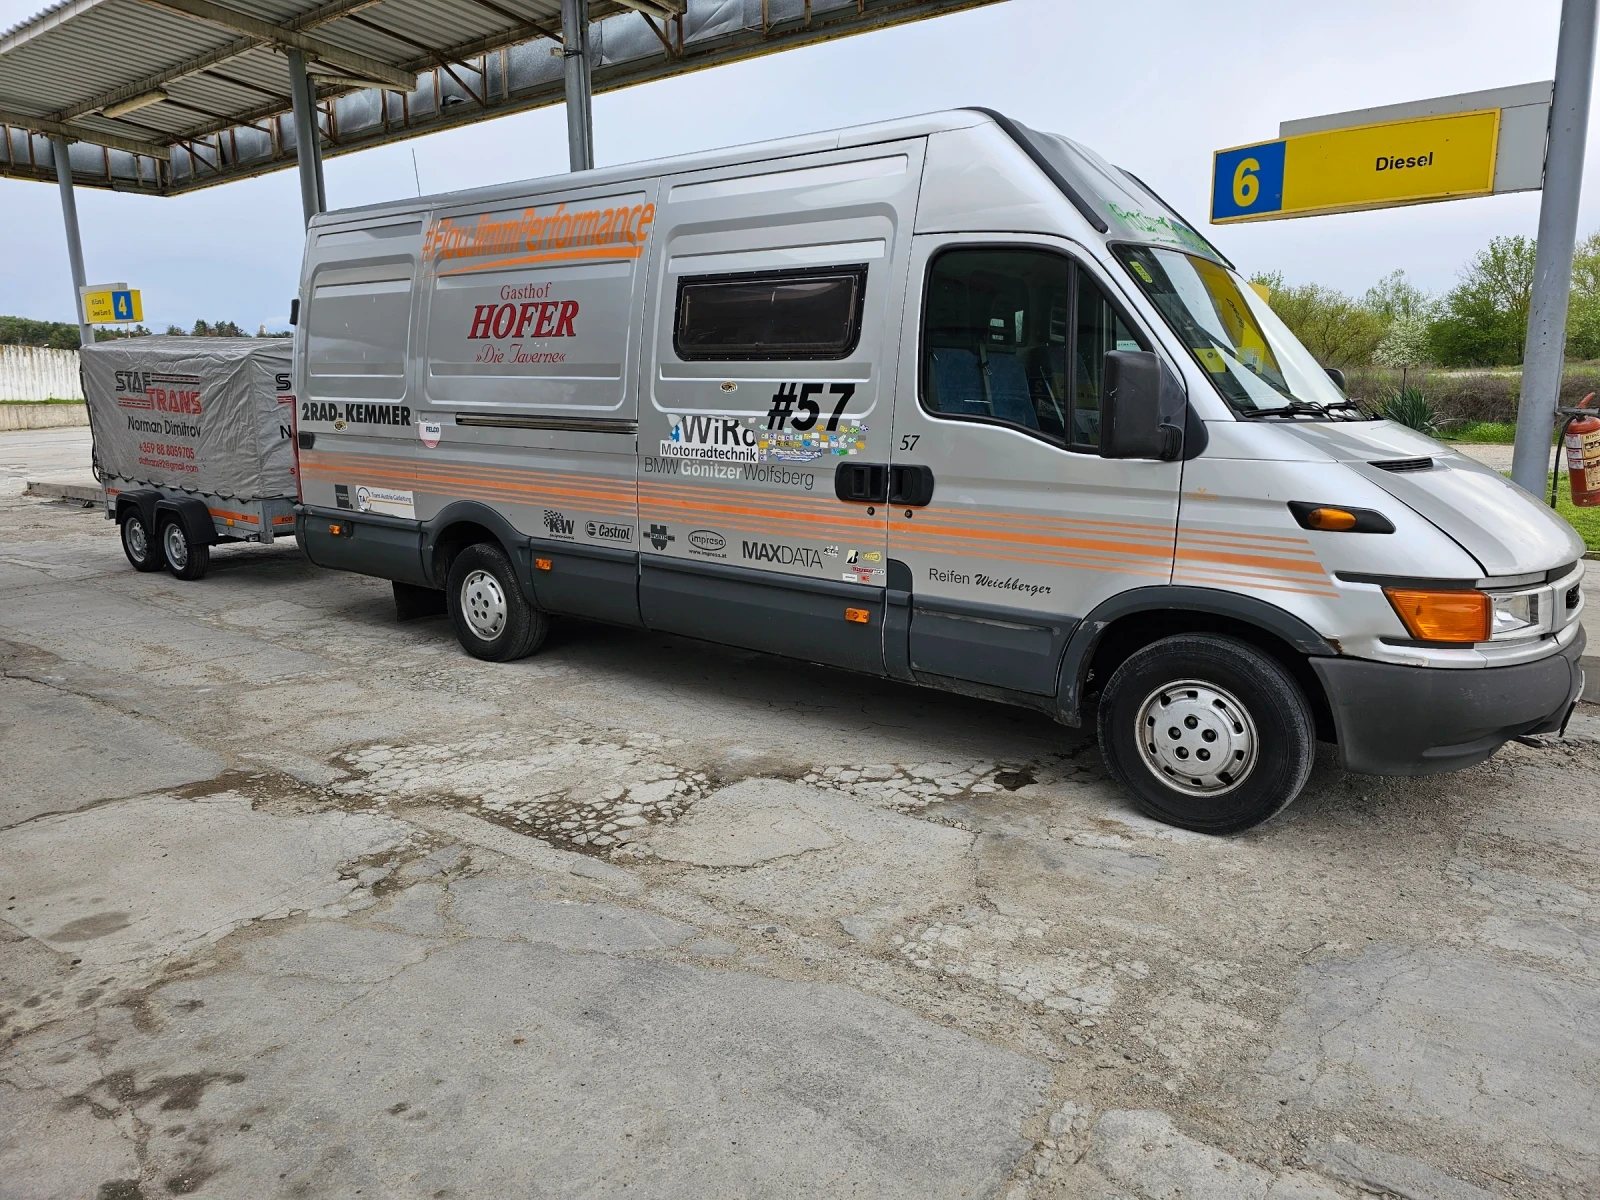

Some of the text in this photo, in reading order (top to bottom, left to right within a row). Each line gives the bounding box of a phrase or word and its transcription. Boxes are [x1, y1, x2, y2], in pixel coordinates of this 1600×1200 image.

[1375, 151, 1434, 173] Diesel
[1232, 157, 1260, 208] 6
[500, 282, 552, 300] Gasthof
[118, 296, 127, 316] 4
[467, 300, 580, 340] HOFER
[115, 371, 150, 393] STAF
[146, 388, 202, 415] TRANS
[767, 383, 856, 432] #57
[127, 416, 201, 437] Norman Dimitrov
[139, 442, 154, 454] +359
[156, 443, 165, 455] 88
[661, 442, 757, 462] Motorradtechnik
[900, 435, 921, 451] 57
[644, 457, 815, 490] BMW Gönitzer Wolfsberg
[550, 518, 575, 534] KW
[598, 524, 631, 540] Castrol
[691, 534, 724, 546] impresa
[742, 540, 823, 569] MAXDATA
[929, 567, 1052, 596] Reifen Weichberger
